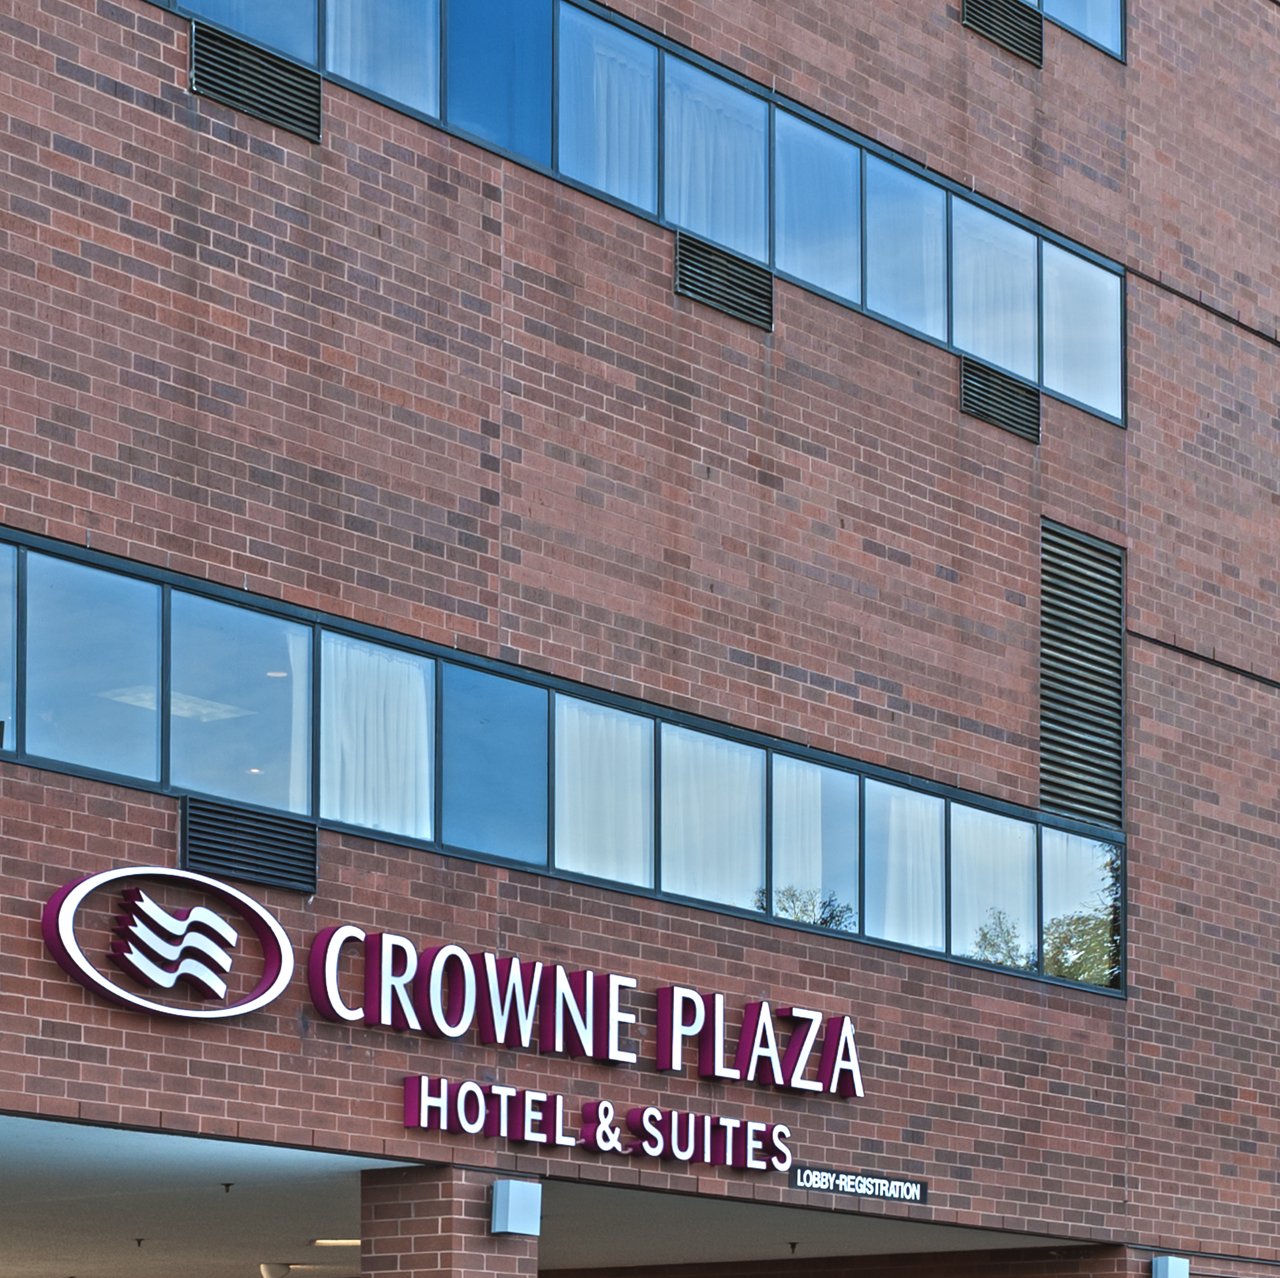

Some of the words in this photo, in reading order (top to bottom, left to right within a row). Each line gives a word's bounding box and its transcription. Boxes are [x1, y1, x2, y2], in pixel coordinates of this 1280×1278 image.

[322, 924, 638, 1064] CROWNE
[668, 985, 865, 1098] PLAZA
[417, 1074, 577, 1147] HOTEL
[593, 1099, 624, 1152] &
[640, 1106, 793, 1172] SUITES
[796, 1168, 921, 1201] LOBBY-REGISTRATION
